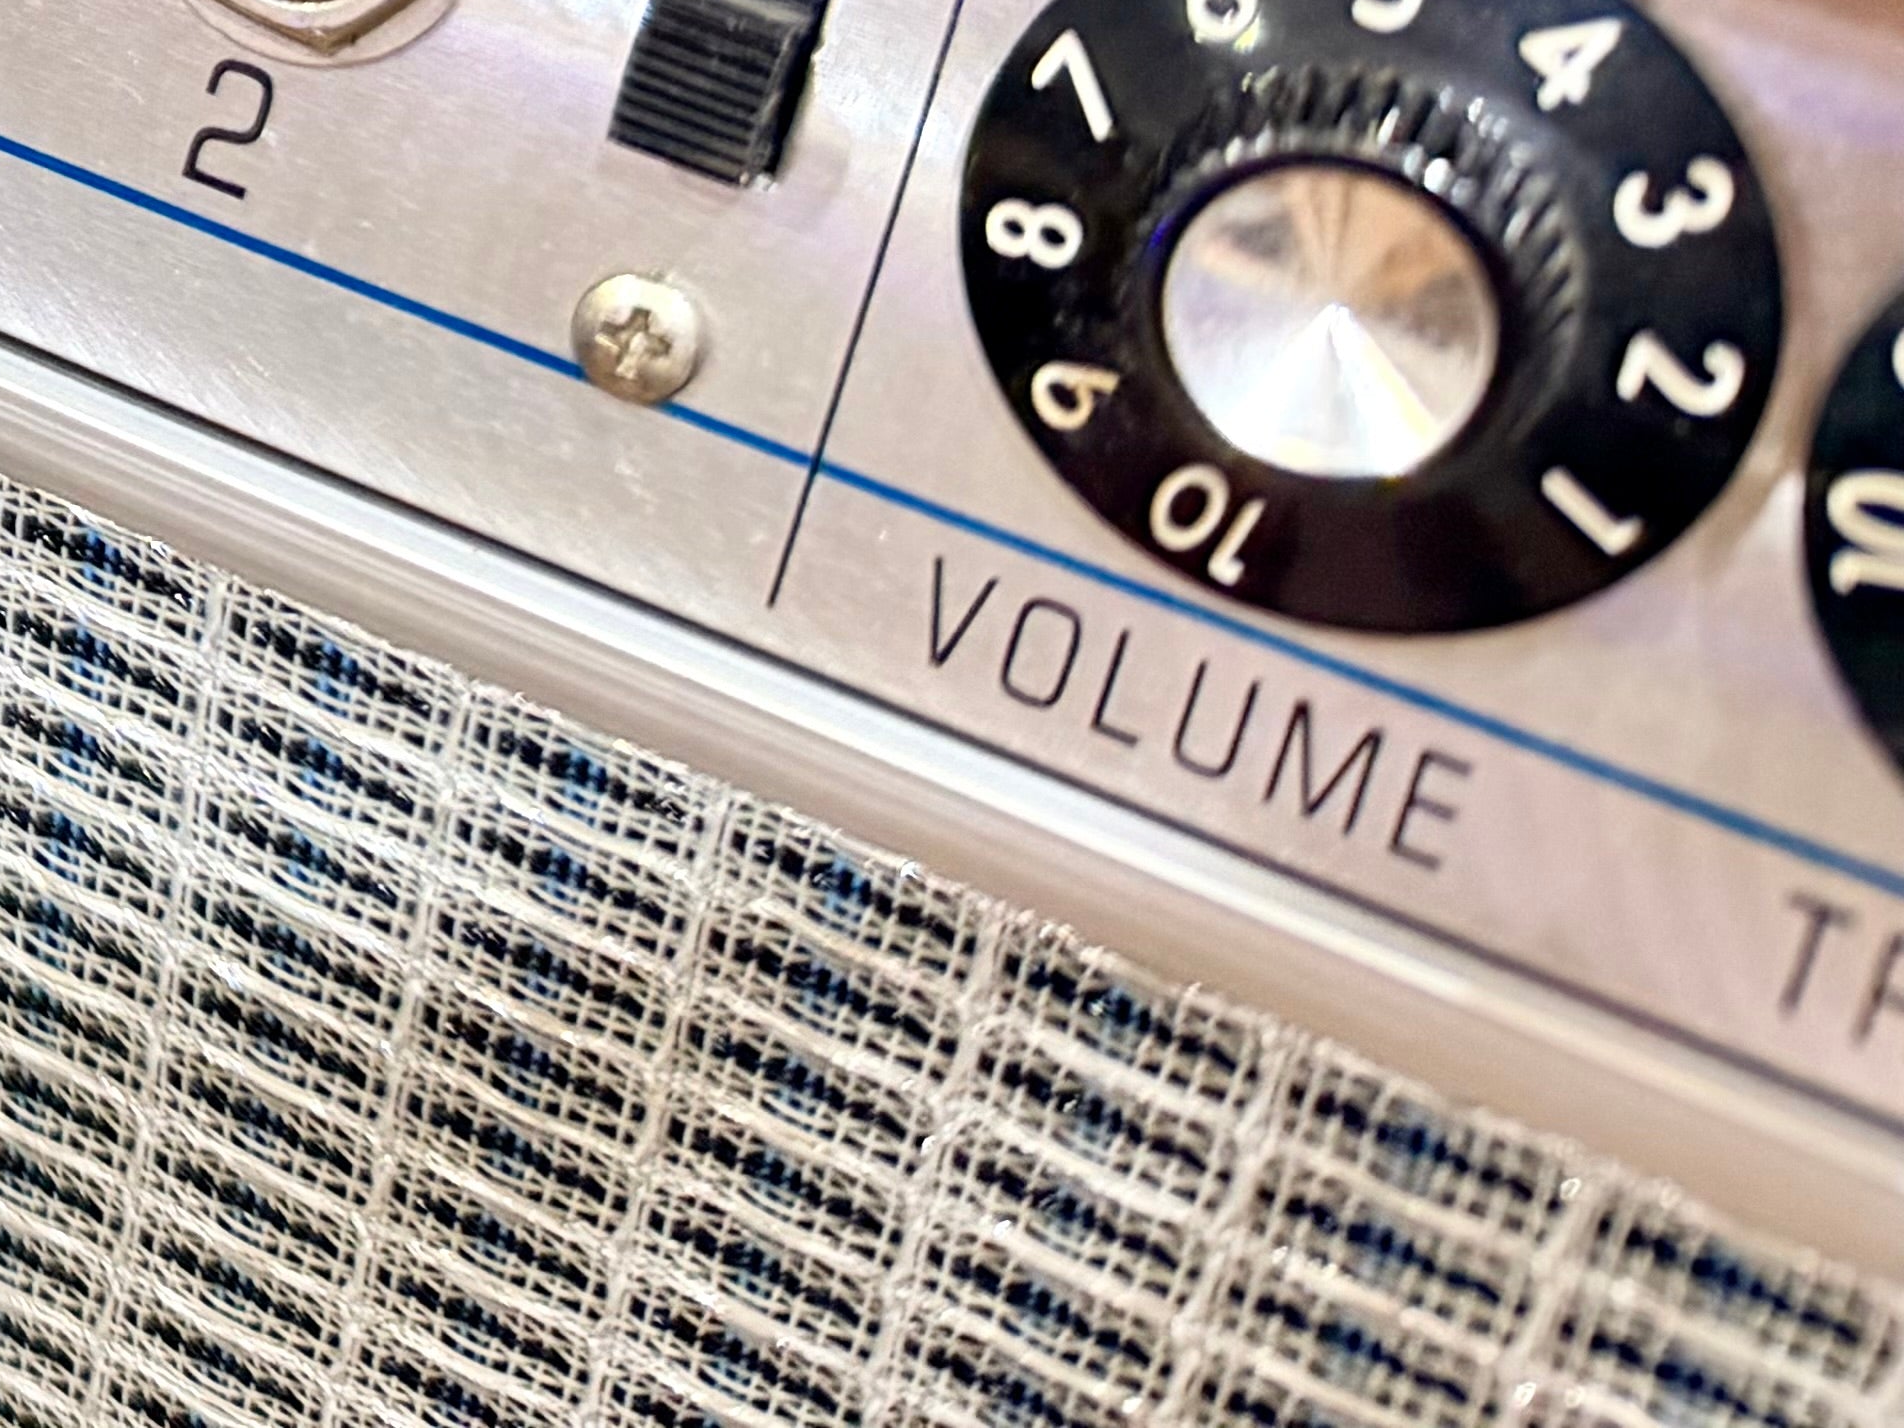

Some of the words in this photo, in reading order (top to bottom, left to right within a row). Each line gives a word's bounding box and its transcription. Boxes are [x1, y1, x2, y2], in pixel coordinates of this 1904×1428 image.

[1030, 29, 1113, 140] 7
[1519, 17, 1622, 111] 4
[182, 59, 275, 200] 2
[984, 198, 1084, 270] 8
[1613, 156, 1733, 248] 3
[1617, 330, 1746, 418] 2
[1150, 465, 1266, 586] 10
[1540, 466, 1642, 557] 1
[927, 556, 1474, 872] VOLUME
